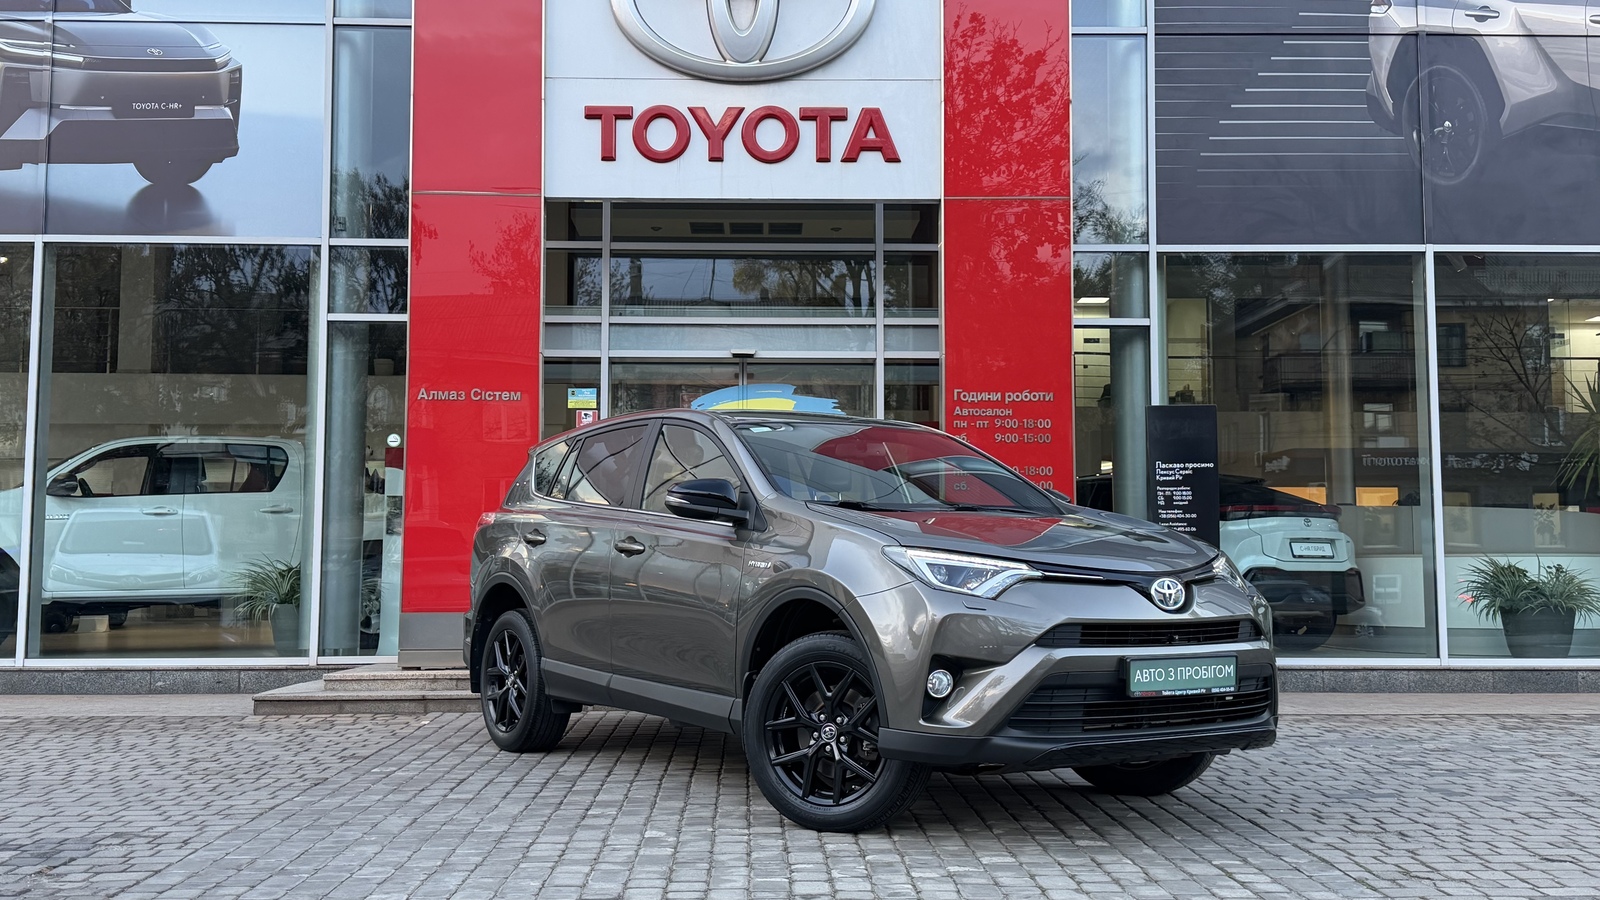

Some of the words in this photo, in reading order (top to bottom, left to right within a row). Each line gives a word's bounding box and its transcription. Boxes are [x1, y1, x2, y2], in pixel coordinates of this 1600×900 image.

[132, 102, 159, 110] TOYOTA
[160, 102, 182, 110] C-HR+
[584, 105, 901, 164] TOYOTA
[417, 387, 466, 401] Алмаз
[470, 387, 522, 401] Сістем
[953, 389, 1001, 403] Години
[1005, 389, 1054, 404] роботи
[953, 406, 1013, 416] Автосалон
[953, 420, 968, 428] пн
[976, 420, 989, 428] пт
[994, 418, 1052, 429] 9:00-18:00
[994, 433, 1052, 443] 9:00-15:00
[1185, 462, 1214, 470] просимо
[1134, 668, 1165, 683] АВТО
[1168, 667, 1175, 681] З
[1177, 664, 1234, 680] ПРОБІГОМ
